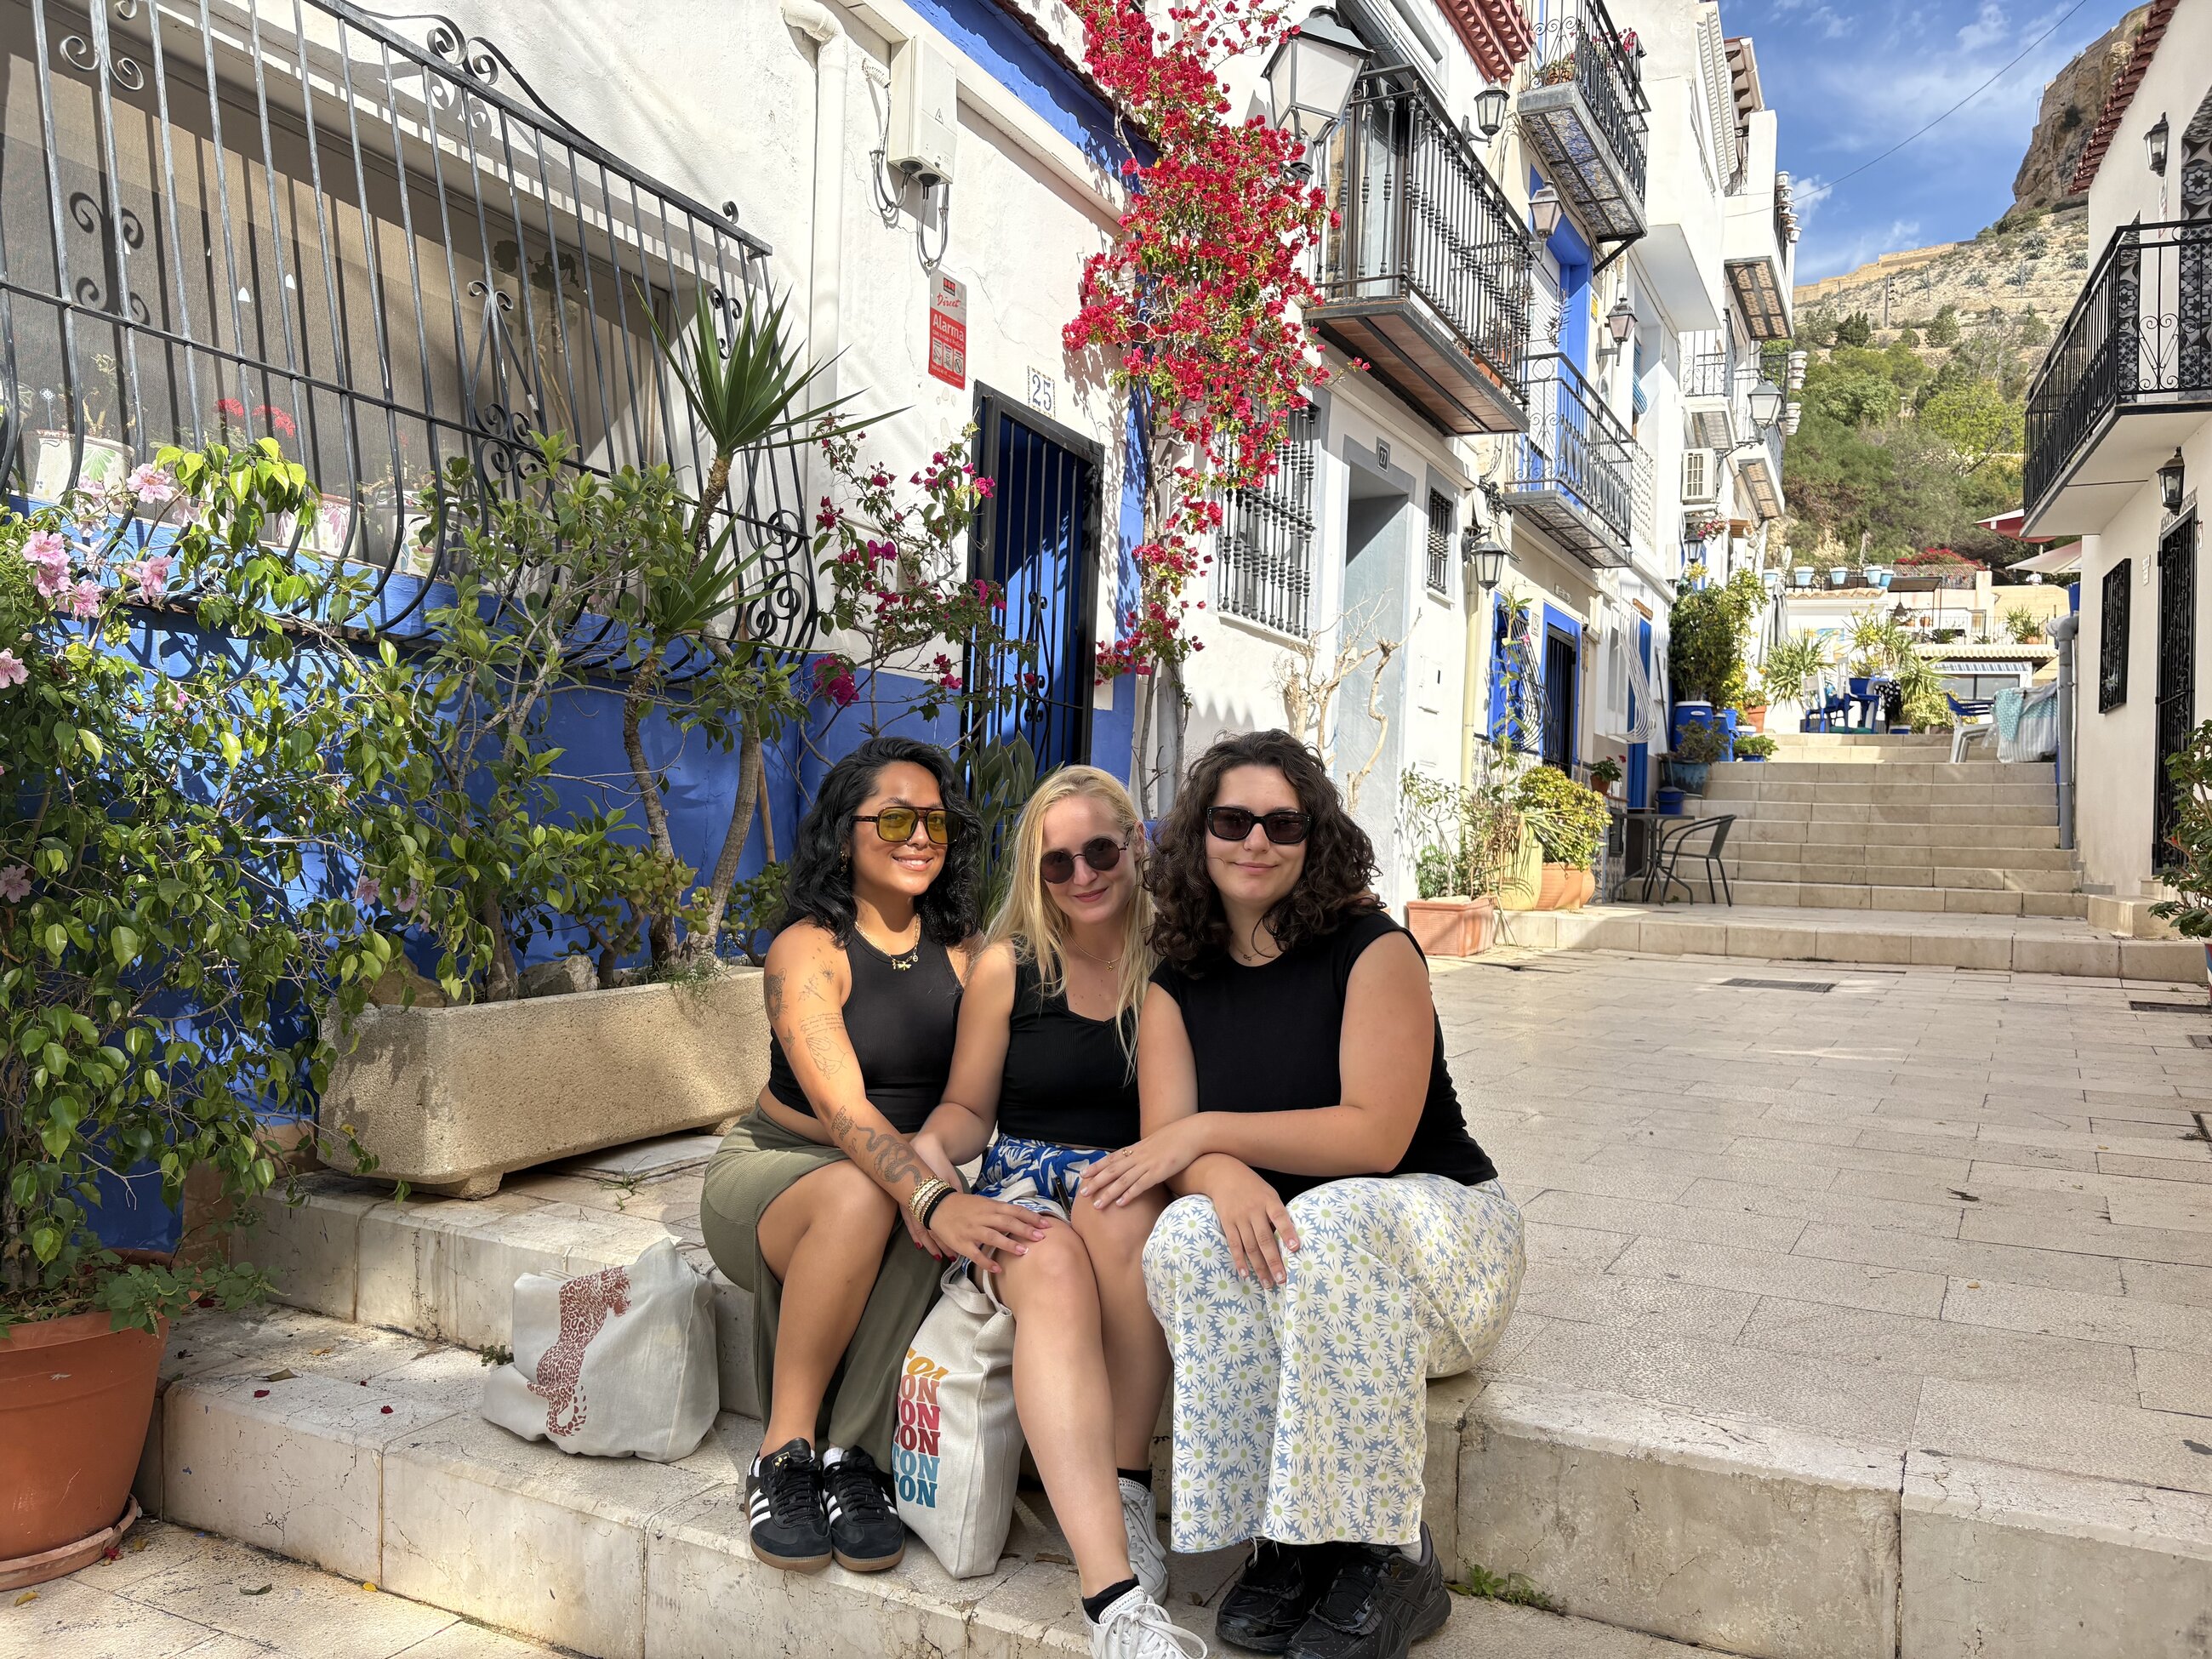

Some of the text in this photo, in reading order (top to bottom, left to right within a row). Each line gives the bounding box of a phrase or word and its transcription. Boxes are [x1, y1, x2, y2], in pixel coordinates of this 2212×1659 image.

[937, 293, 961, 308] Direct
[932, 313, 965, 343] Alarma
[1032, 374, 1052, 411] 25
[1380, 451, 1387, 465] 27
[898, 1395, 941, 1431] ON
[894, 1424, 941, 1457] ON
